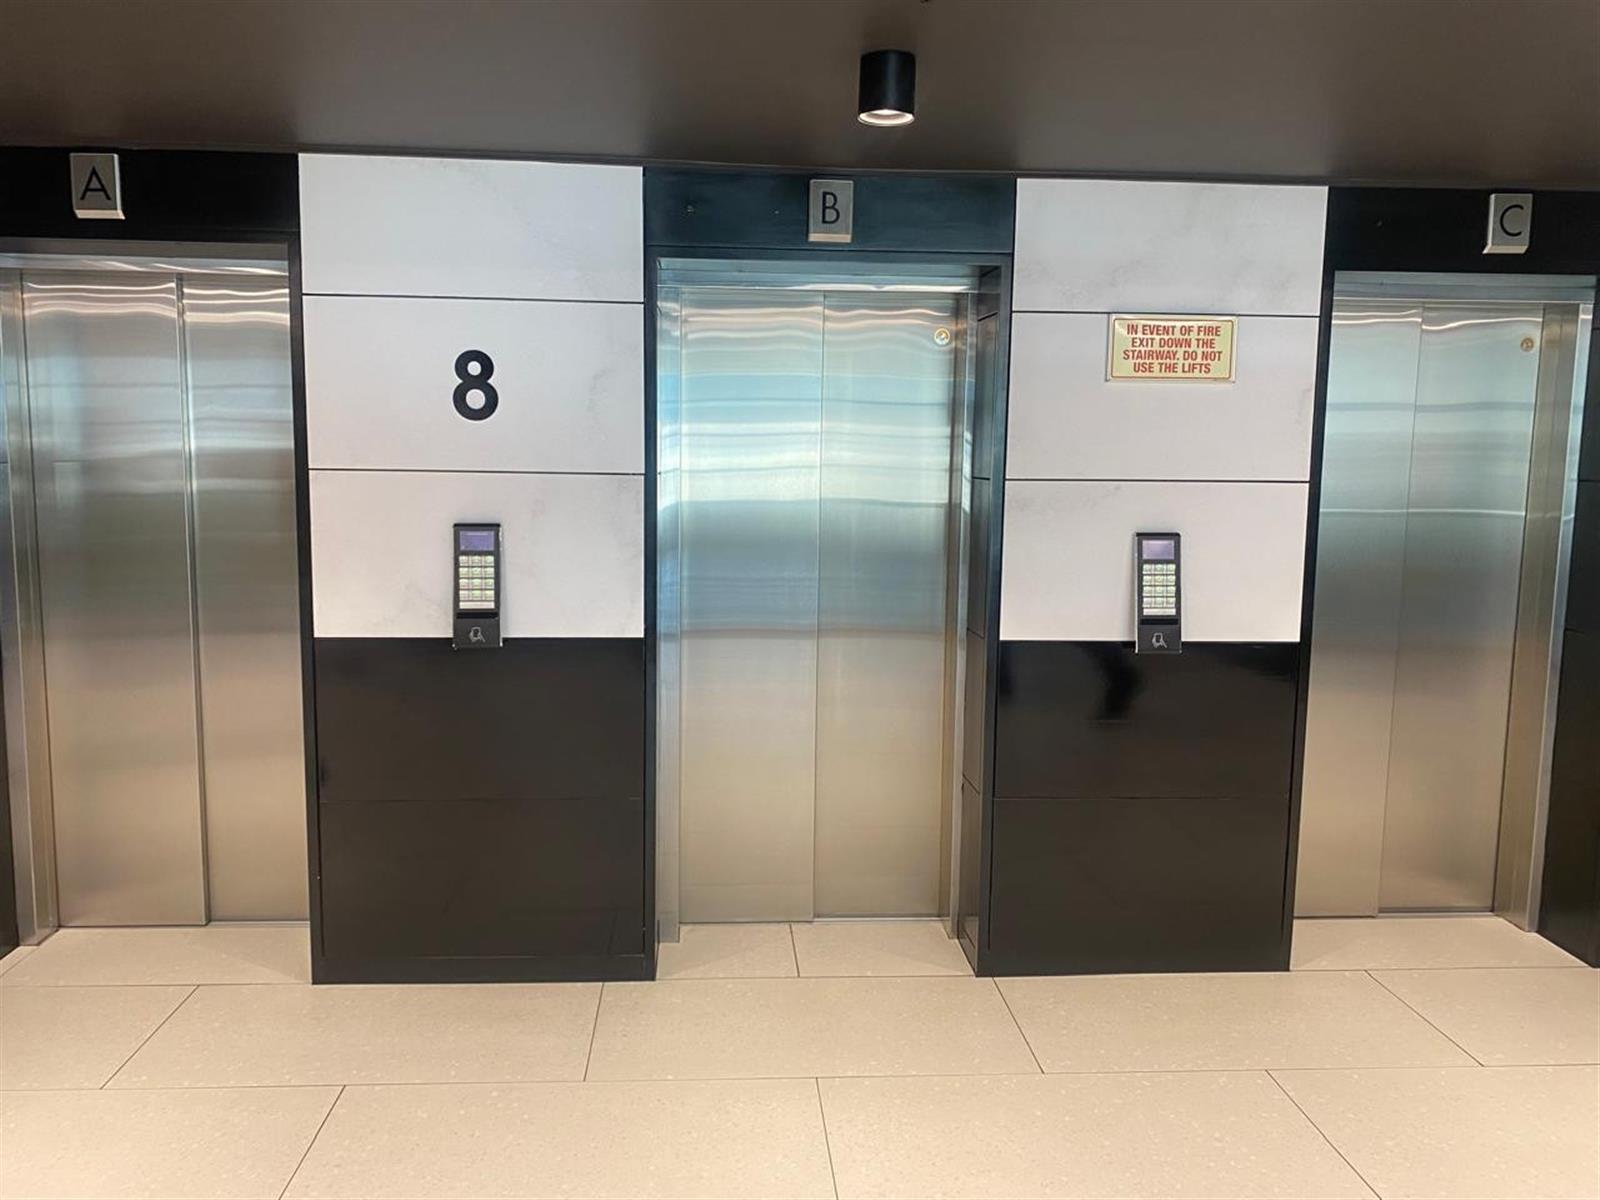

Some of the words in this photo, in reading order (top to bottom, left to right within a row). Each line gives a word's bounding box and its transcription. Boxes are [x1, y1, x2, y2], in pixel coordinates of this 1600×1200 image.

[80, 164, 111, 200] A
[822, 191, 840, 224] B
[1500, 204, 1524, 237] C
[1127, 324, 1138, 335] IN
[1142, 324, 1176, 336] EVENT
[1180, 325, 1195, 336] OF
[1197, 325, 1221, 336] FIRE
[1131, 337, 1156, 348] EXIT
[1158, 338, 1192, 348] DOWN
[1195, 338, 1216, 349] THE
[1183, 350, 1198, 361] DO
[1201, 351, 1222, 361] NOT
[1133, 362, 1154, 373] USE
[1158, 362, 1178, 373] THE
[1181, 363, 1211, 374] LIFTS
[453, 349, 499, 421] 8
